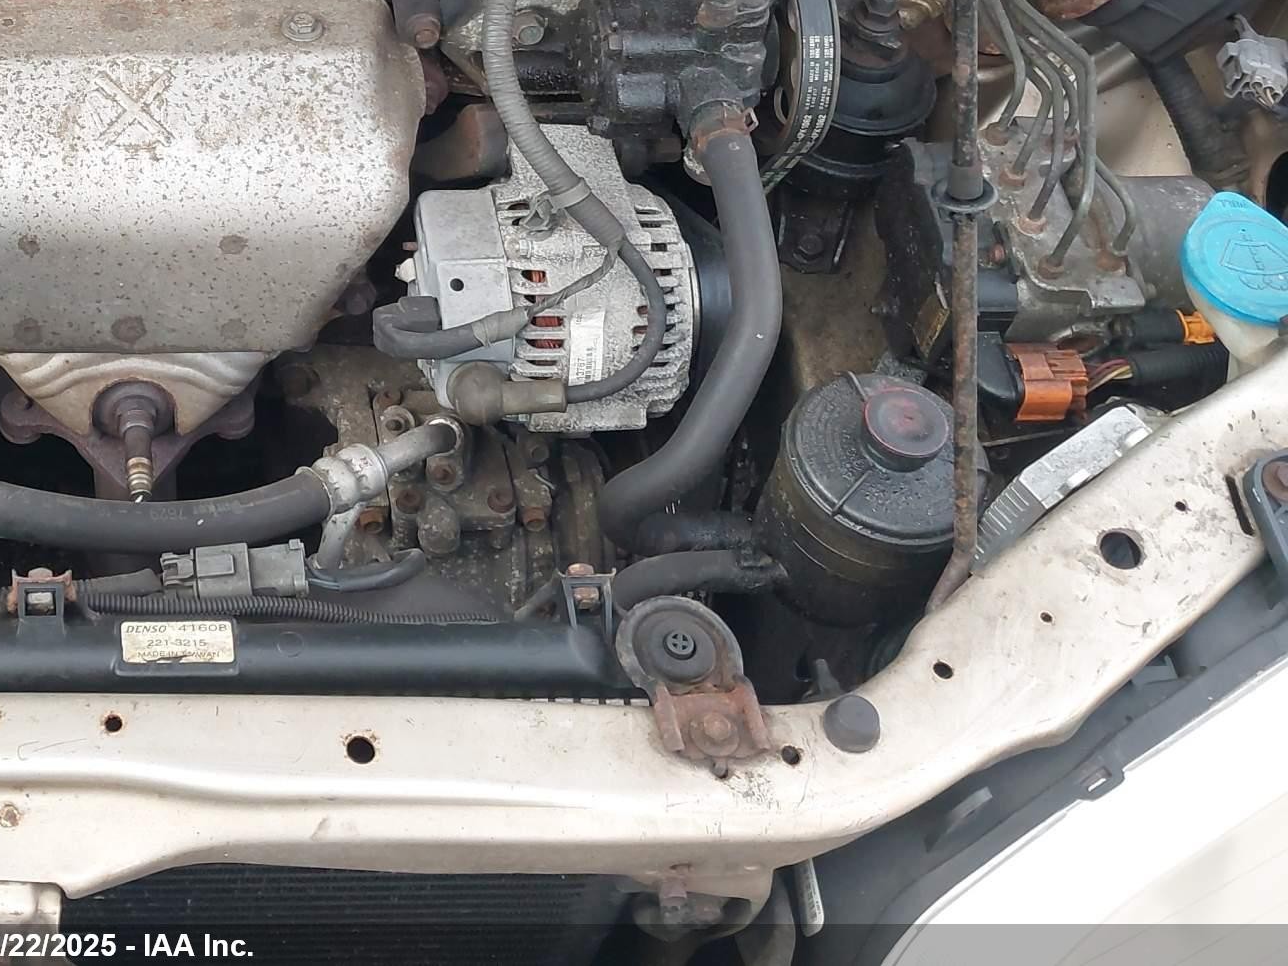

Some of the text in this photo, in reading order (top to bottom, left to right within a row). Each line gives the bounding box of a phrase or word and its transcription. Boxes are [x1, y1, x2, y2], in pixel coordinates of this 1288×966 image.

[125, 624, 168, 634] DENSO
[146, 638, 208, 647] 221-3215
[137, 650, 166, 658] MADE
